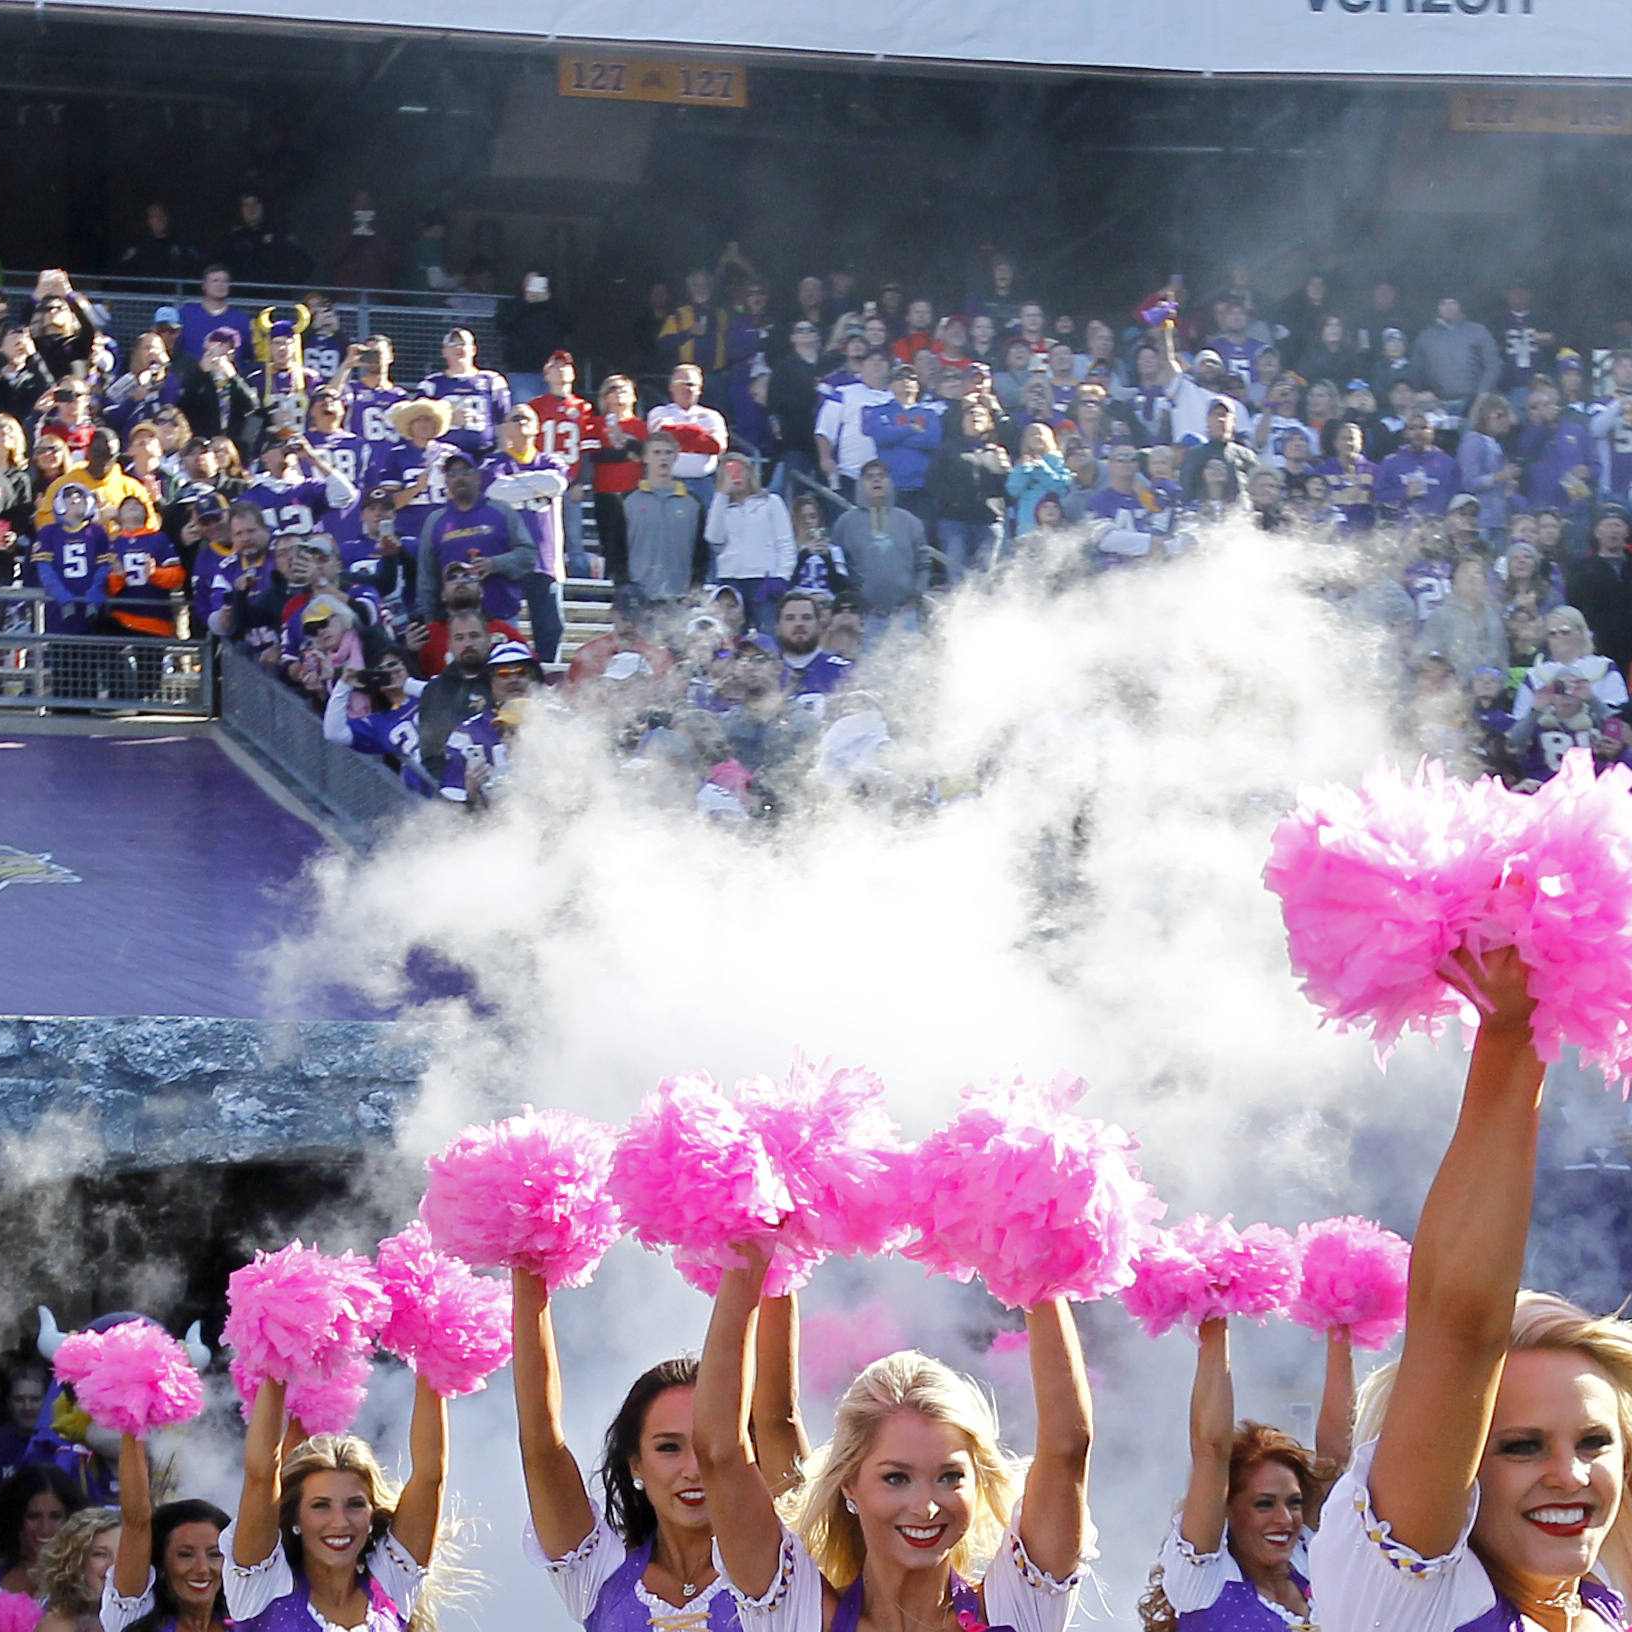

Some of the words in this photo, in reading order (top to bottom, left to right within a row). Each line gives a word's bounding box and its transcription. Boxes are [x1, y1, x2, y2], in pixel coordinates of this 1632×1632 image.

[570, 60, 628, 93] 127
[678, 67, 736, 100] 127
[540, 420, 582, 465] 13
[62, 542, 89, 579] 5
[122, 551, 150, 587] 5
